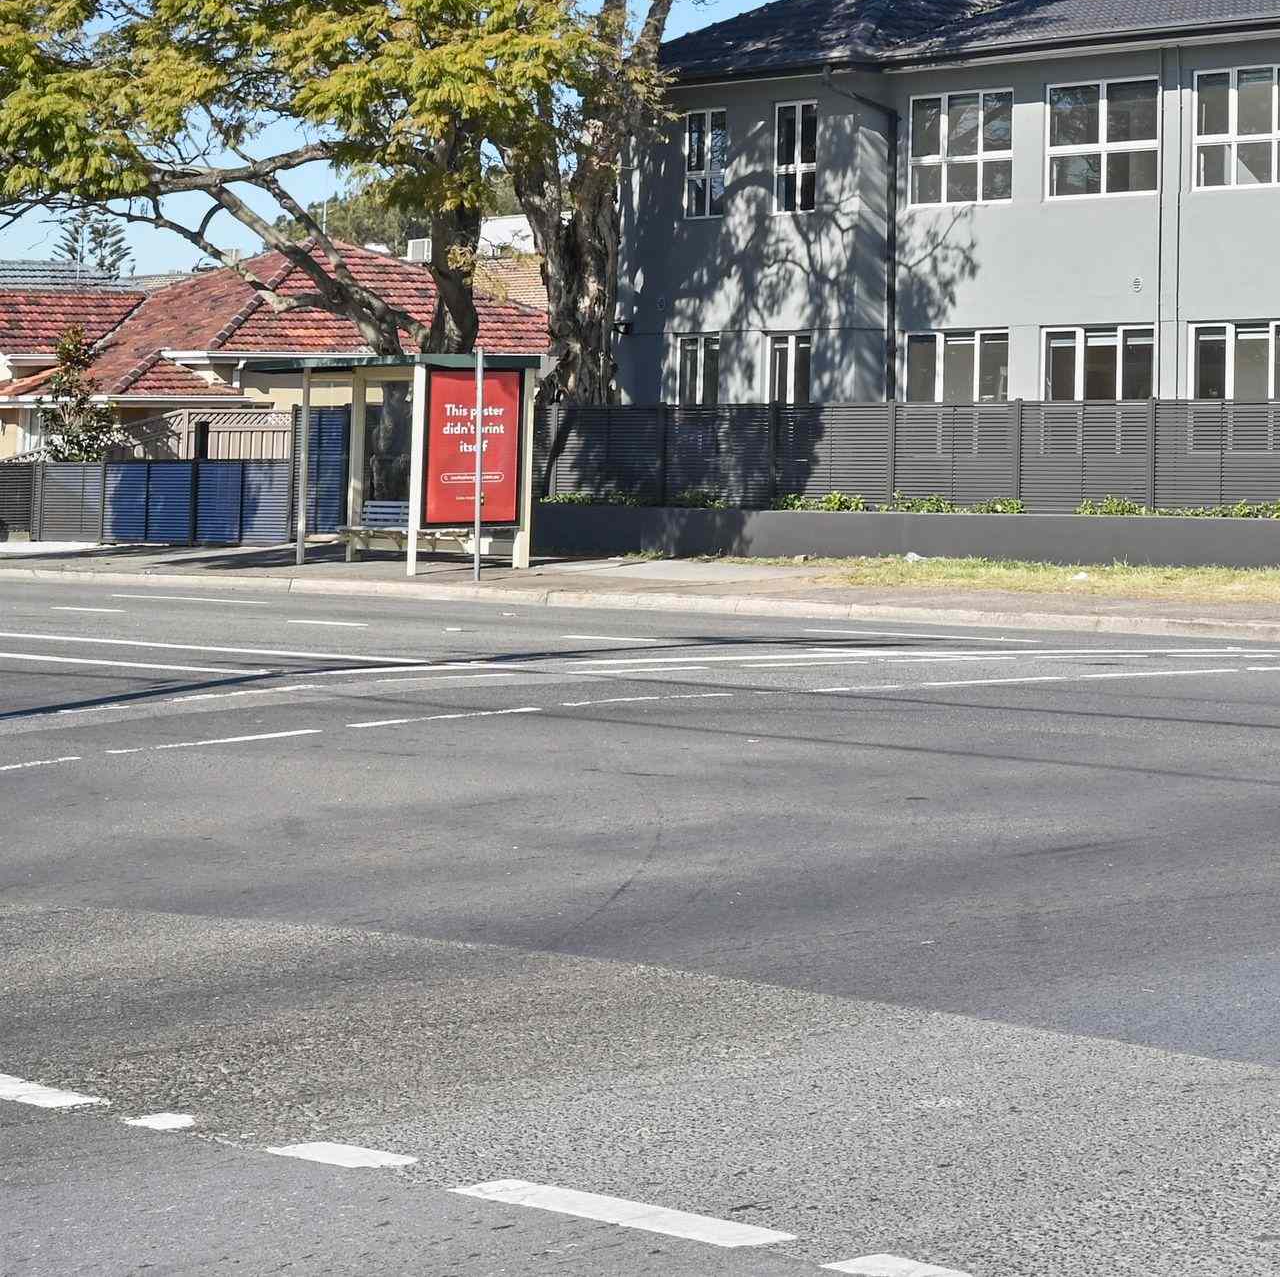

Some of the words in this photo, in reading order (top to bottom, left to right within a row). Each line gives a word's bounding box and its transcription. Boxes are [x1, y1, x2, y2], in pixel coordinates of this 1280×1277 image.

[445, 403, 468, 416] This
[470, 406, 504, 420] pster
[443, 422, 475, 434] didn't
[478, 422, 505, 434] rint
